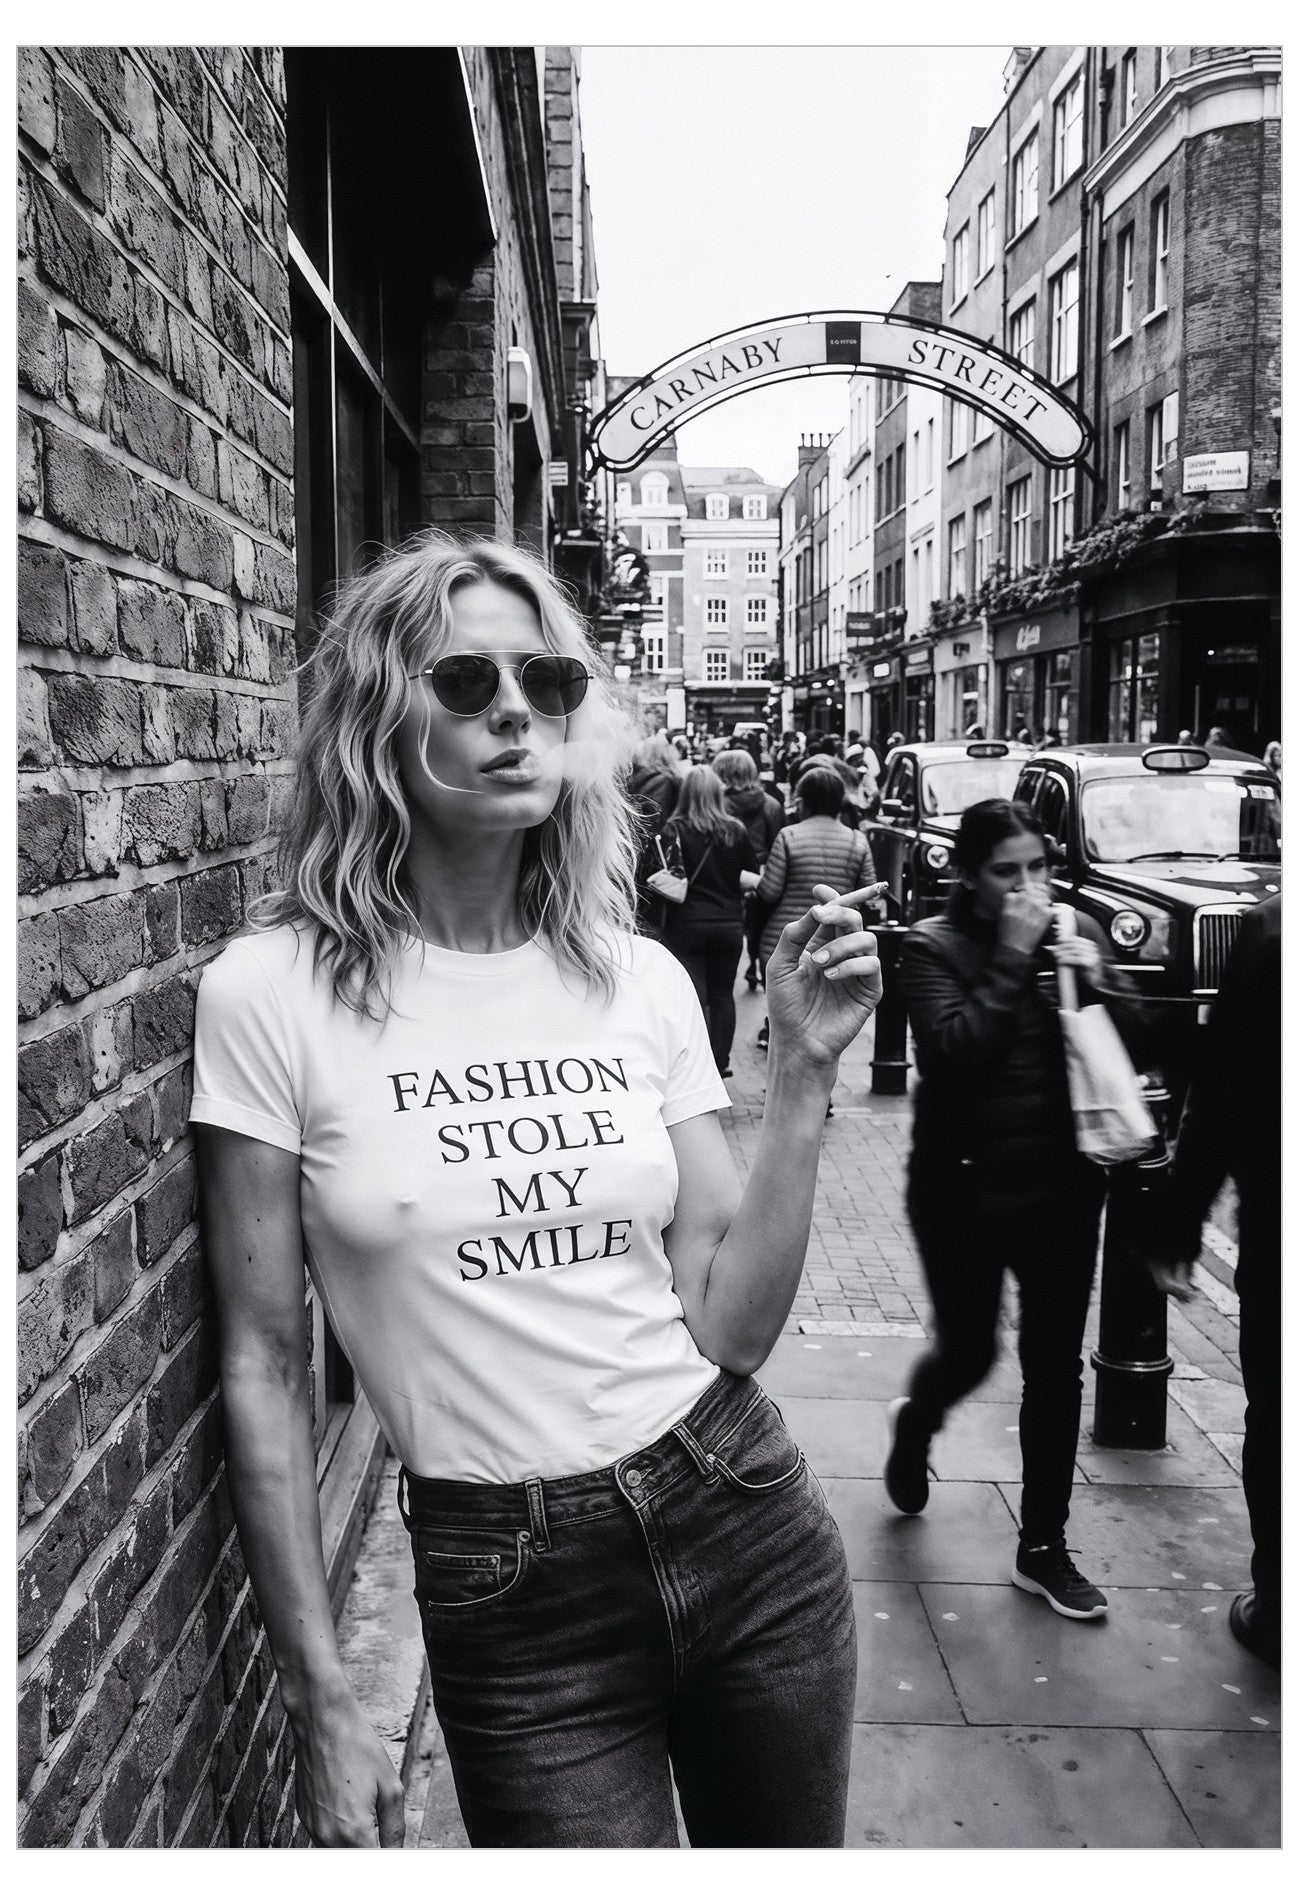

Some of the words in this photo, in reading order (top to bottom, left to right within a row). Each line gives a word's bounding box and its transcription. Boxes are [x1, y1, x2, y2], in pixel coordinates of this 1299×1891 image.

[629, 337, 784, 431] CARNABY
[907, 339, 1047, 422] STREET
[387, 1058, 629, 1112] FASHION
[438, 1110, 624, 1164] STOLE
[491, 1167, 589, 1218] MY
[457, 1219, 632, 1281] SMILE
